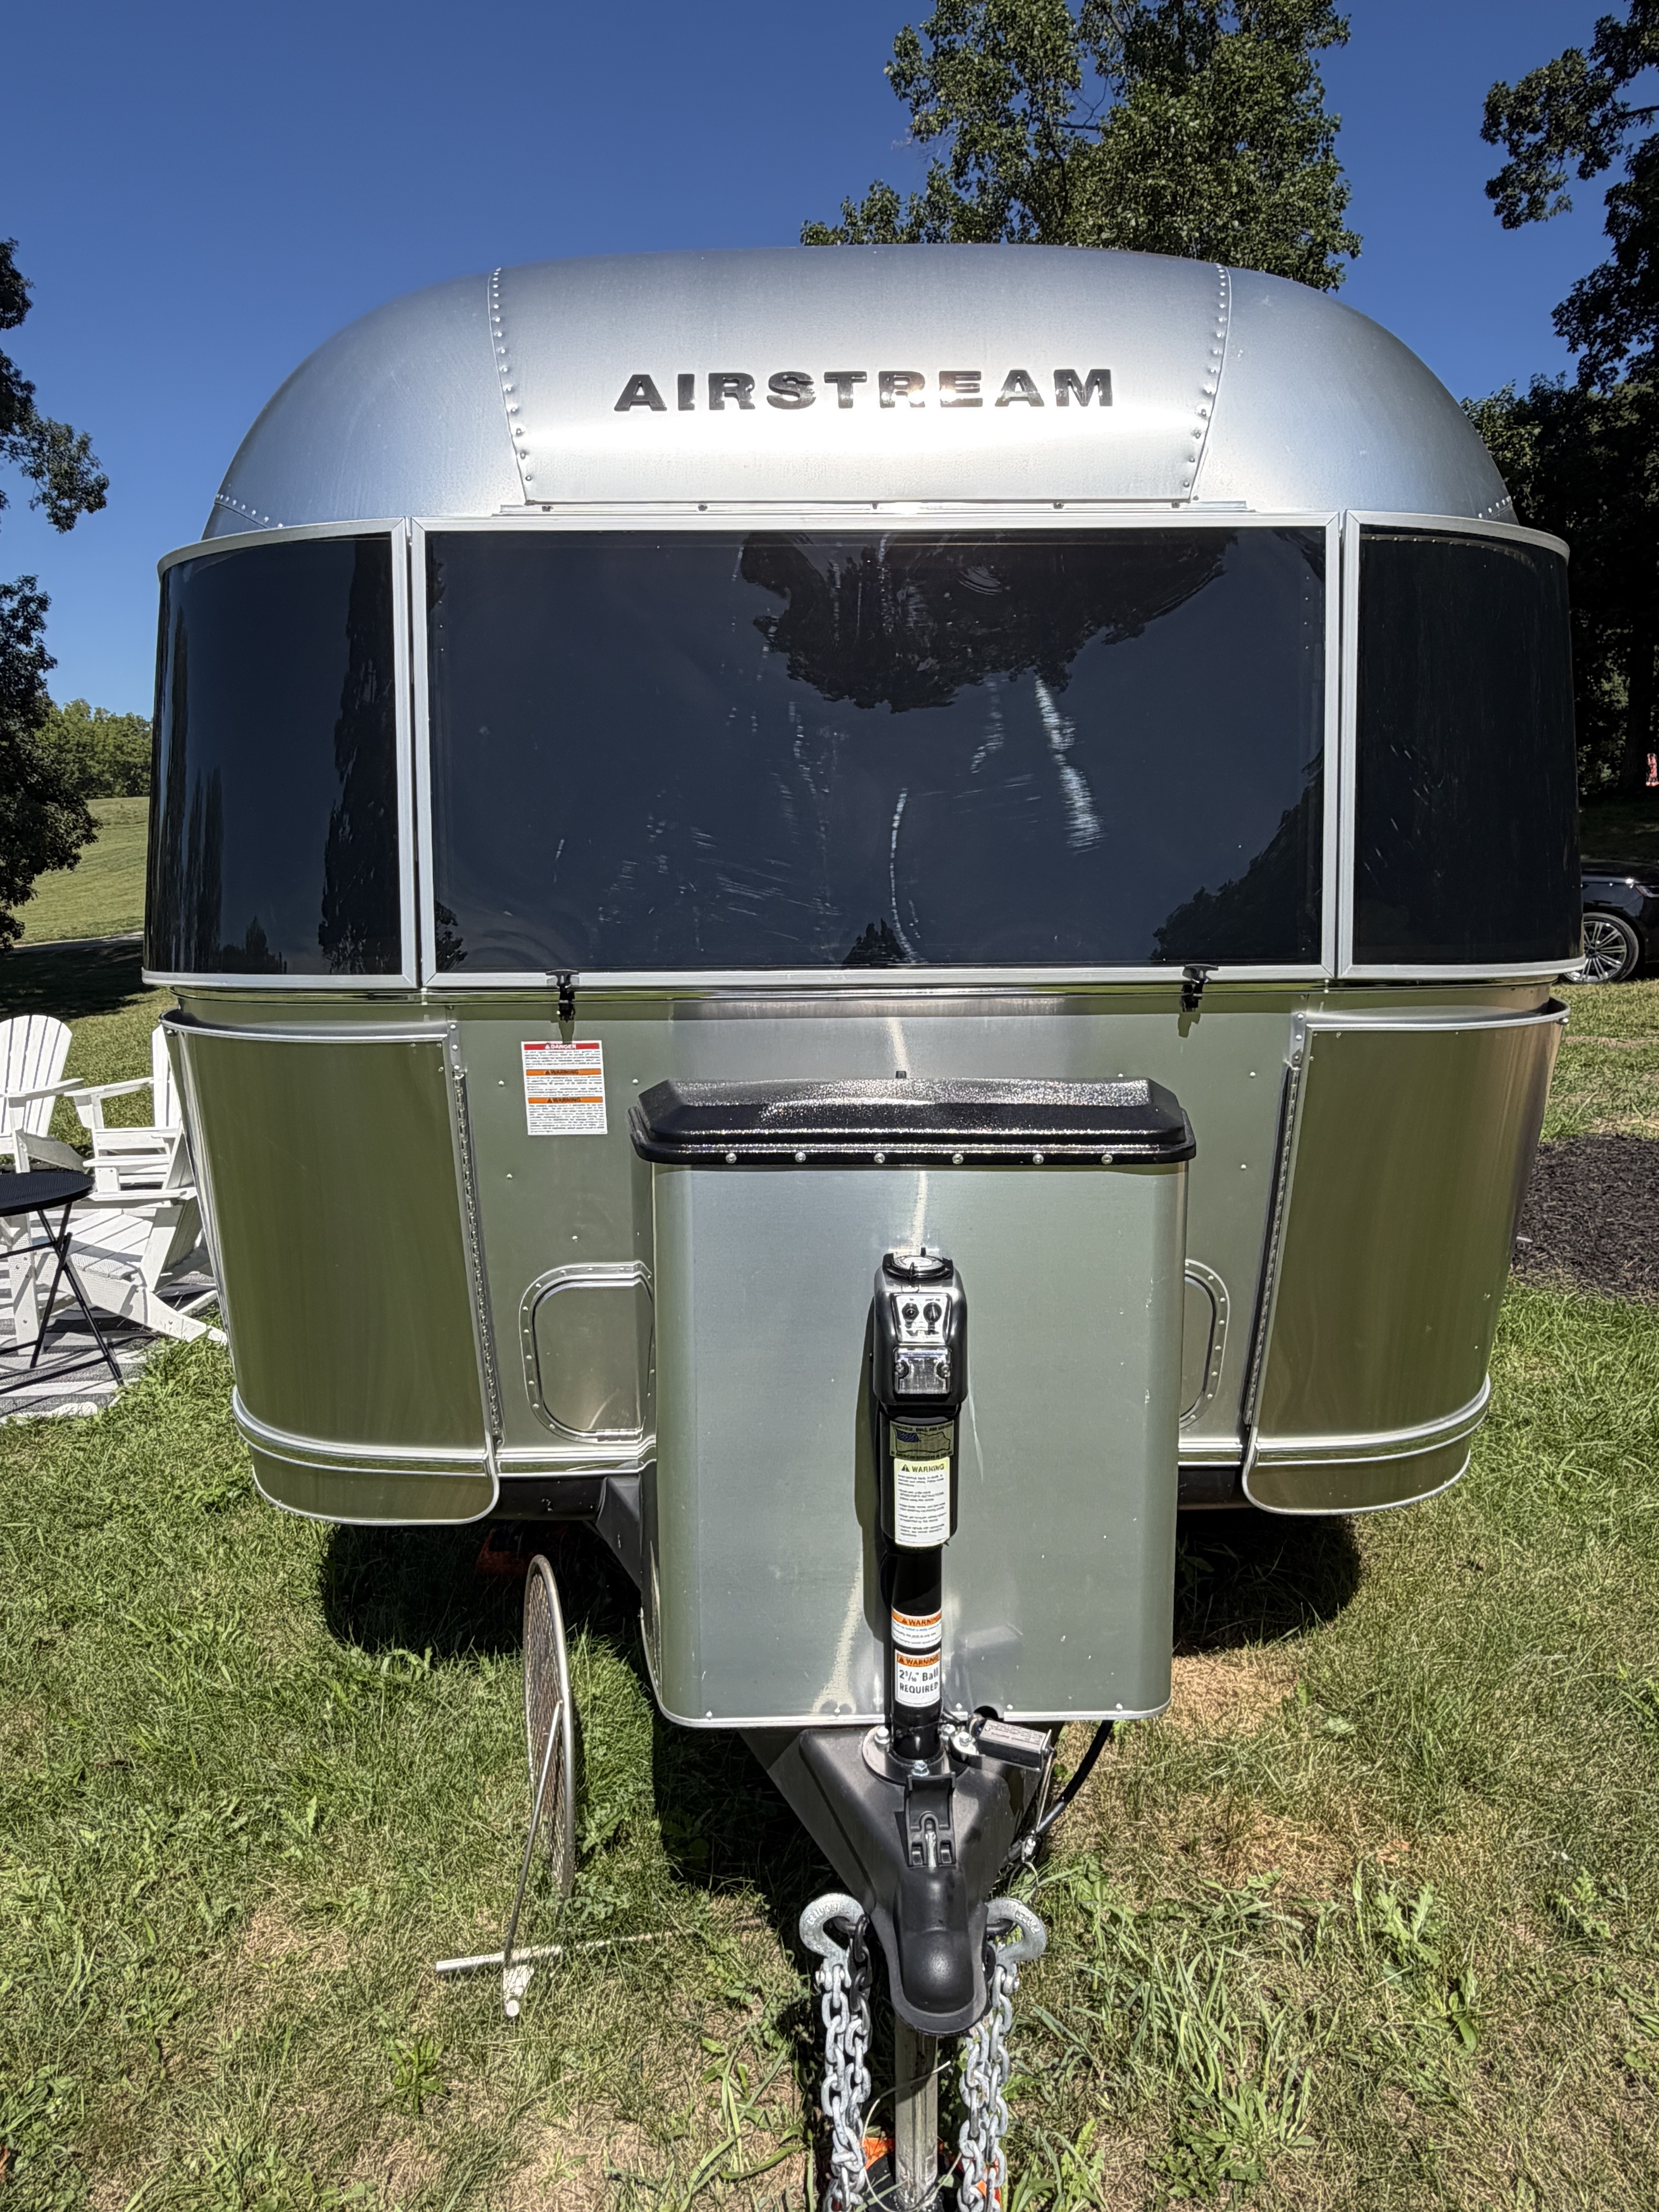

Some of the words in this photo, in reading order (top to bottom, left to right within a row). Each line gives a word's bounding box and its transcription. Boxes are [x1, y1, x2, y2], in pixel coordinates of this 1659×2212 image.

[614, 369, 1113, 412] AIRSTREAM
[912, 1463, 944, 1472] WARNING
[907, 1654, 939, 1665] WARNING
[922, 1667, 938, 1681] Ball
[900, 1681, 938, 1694] REQUIRED
